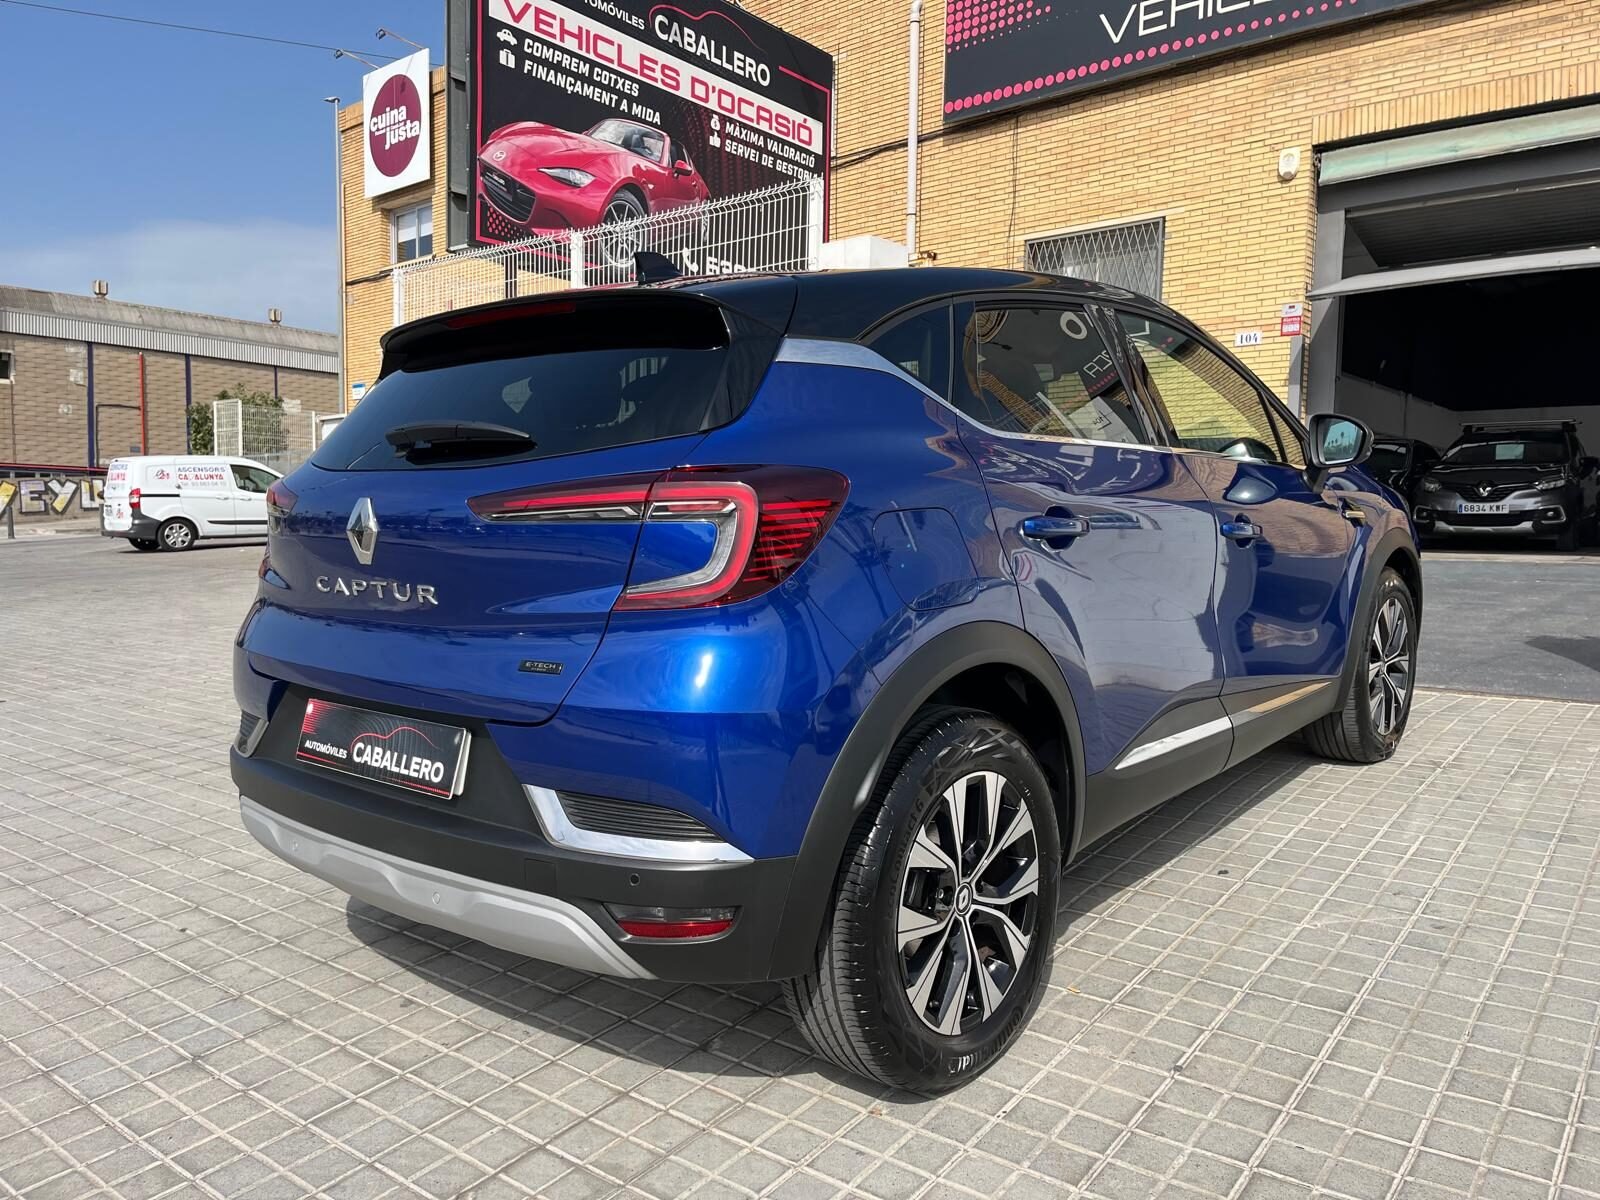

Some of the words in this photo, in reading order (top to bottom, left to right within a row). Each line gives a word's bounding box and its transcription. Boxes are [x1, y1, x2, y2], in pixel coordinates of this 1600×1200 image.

[524, 38, 590, 77] COMPREM
[593, 67, 640, 97] COTXES
[654, 14, 771, 87] CABALLERO
[503, 0, 680, 92] VEHICLES
[691, 75, 812, 147] D'OCASIÓ
[523, 60, 618, 108] FINANÇAMENT
[620, 99, 628, 113] A
[632, 103, 661, 126] MIDA
[370, 105, 406, 133] cuina
[385, 119, 420, 150] justa
[725, 121, 764, 148] MÀXIMA
[767, 138, 815, 168] VALORACIÓ
[725, 139, 759, 163] SERVEI
[762, 154, 774, 168] DE
[1240, 333, 1258, 344] 104
[1464, 504, 1486, 512] 6834
[316, 576, 438, 605] CAPTUR
[304, 739, 348, 760] AUTOMÓVILES
[352, 741, 445, 784] CABALLERO
